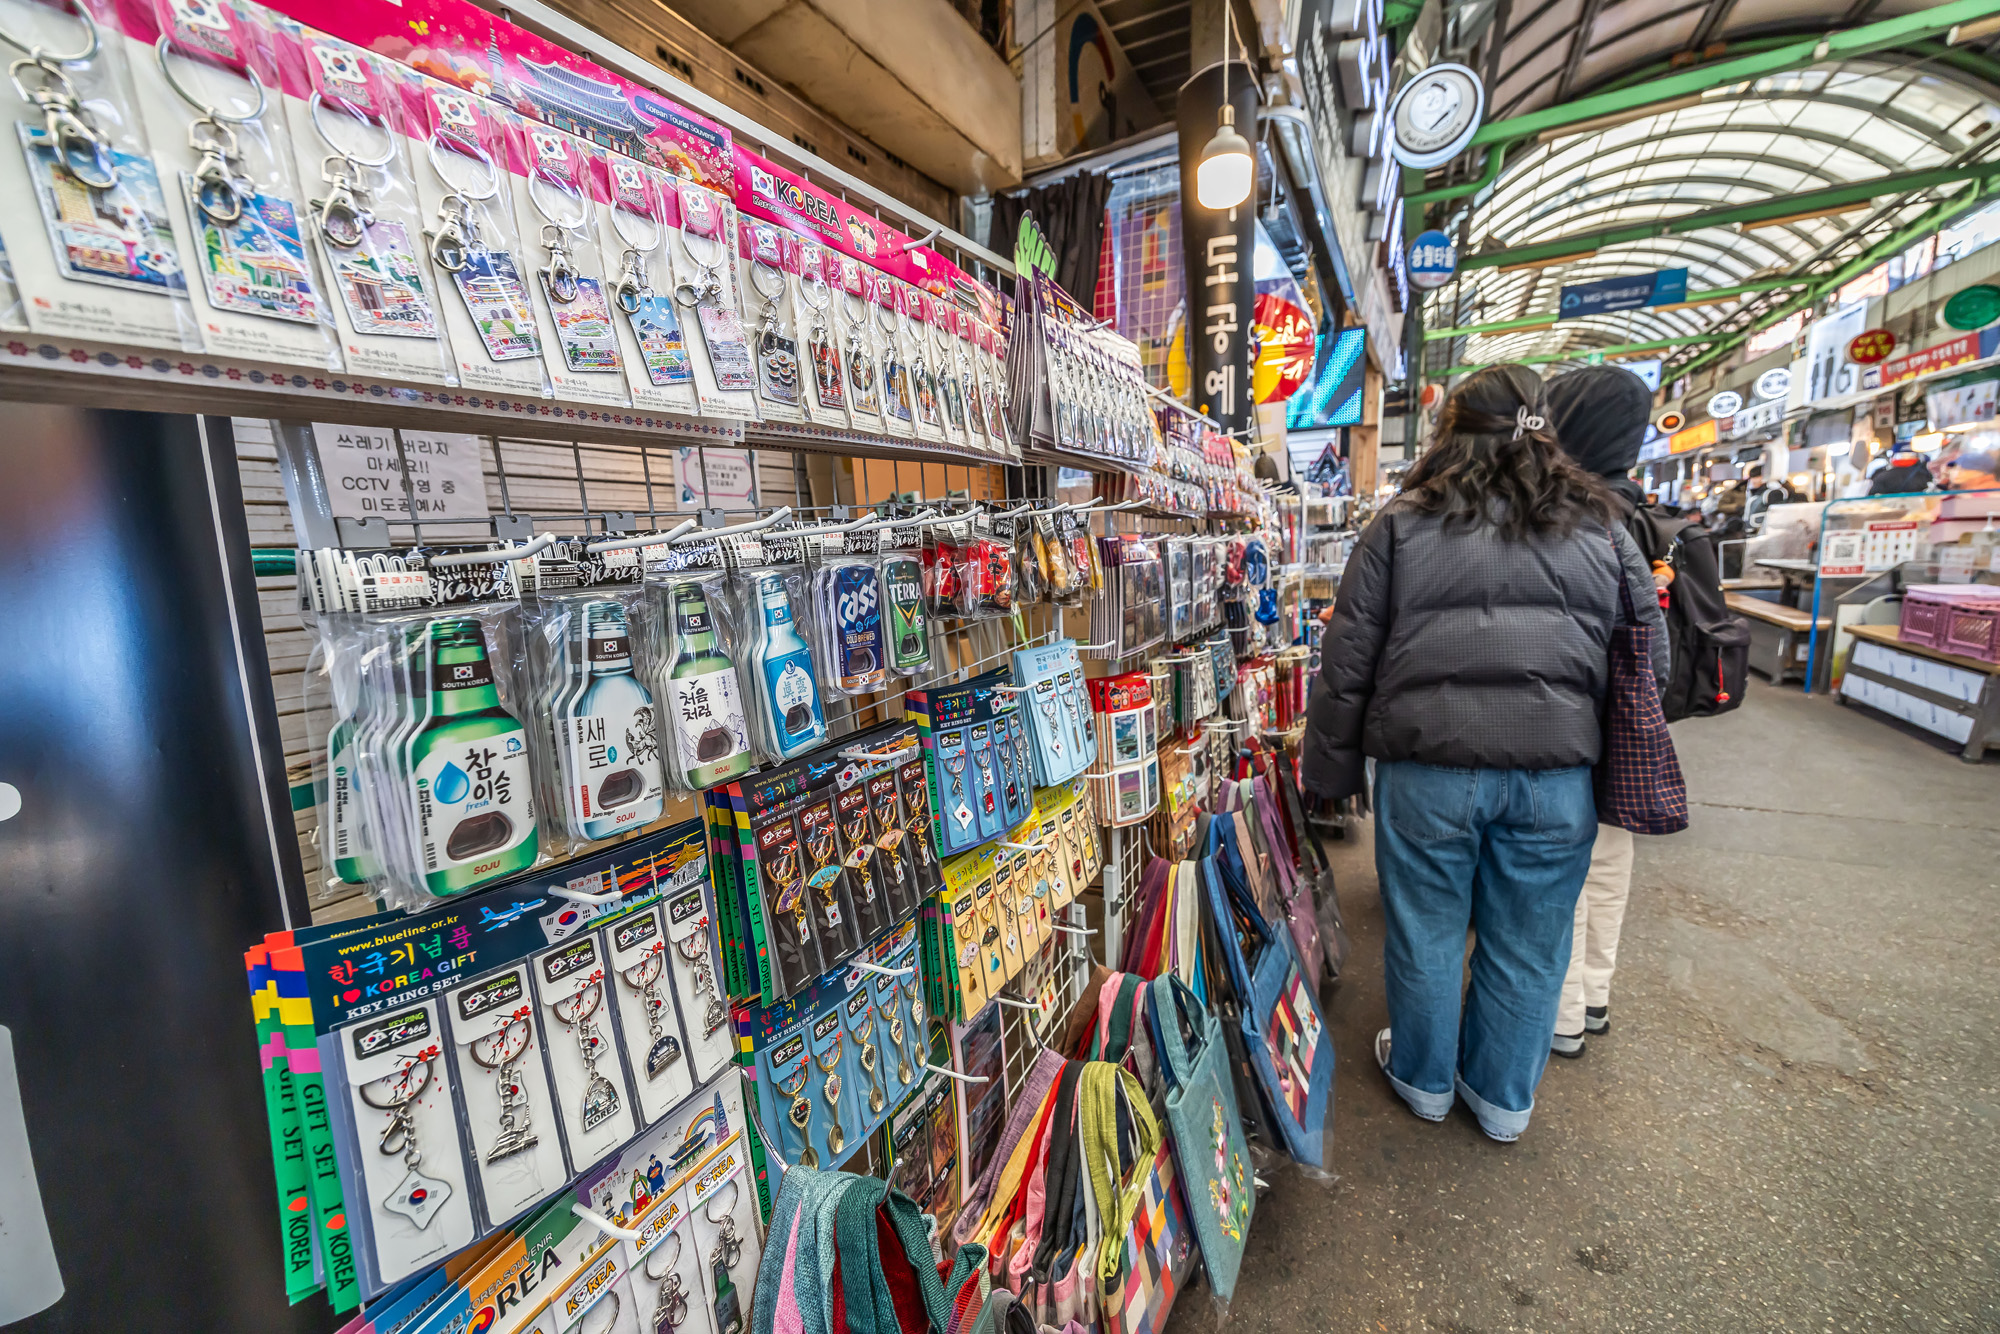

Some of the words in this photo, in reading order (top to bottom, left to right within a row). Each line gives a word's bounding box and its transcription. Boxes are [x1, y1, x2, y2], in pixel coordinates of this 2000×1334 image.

[439, 118, 479, 141] KOREA
[644, 103, 669, 119] Korean
[669, 112, 691, 130] Tourist
[690, 124, 717, 143] Souvenir
[537, 154, 570, 173] KOREA
[617, 184, 646, 202] KOREA
[752, 194, 783, 215] Korean
[782, 206, 822, 233] traditional
[776, 176, 844, 232] KOREA
[250, 288, 299, 305] KOREA
[383, 310, 422, 323] KOREA
[1205, 207, 1239, 438] 도공예
[337, 433, 390, 452] 쓰레기
[402, 440, 450, 456] 버리지
[367, 456, 430, 474] 마세요!!
[341, 476, 390, 491] CCTV
[441, 480, 456, 494] 중
[361, 497, 447, 513] 미도공예사
[848, 538, 880, 553] Korea
[896, 532, 921, 547] Korea
[675, 550, 721, 570] Korea
[766, 548, 802, 566] Korea
[379, 576, 424, 585] 판매가격
[447, 570, 492, 581] AWESOME
[589, 566, 643, 587] Korea
[436, 580, 511, 603] Korea
[888, 582, 922, 604] TERRA
[613, 651, 629, 659] KOREA
[442, 681, 466, 689] SOUTH
[467, 677, 490, 686] KOREA
[679, 686, 709, 707] 처음
[934, 695, 975, 713] 한국기념품
[682, 704, 713, 722] 처럼
[945, 711, 965, 720] KOREA
[964, 708, 976, 716] GIFT
[940, 721, 951, 729] KEY
[587, 717, 609, 770] 새로
[465, 747, 512, 805] 참이슬
[714, 764, 731, 775] SOJU
[754, 767, 801, 788] www.blueline.or.kr
[753, 773, 808, 807] 한국기념품
[926, 753, 934, 776] GIFT
[930, 779, 938, 798] SET
[934, 820, 943, 848] KOREA
[463, 797, 490, 815] fresh
[615, 811, 637, 824] SOJU
[473, 860, 501, 876] SOJU
[570, 876, 599, 890] 판매가격
[746, 866, 758, 897] GIFT
[751, 903, 762, 926] SET
[338, 914, 459, 956] www.blueline.or.kr
[757, 939, 765, 948] I
[327, 925, 473, 986] 한국기념품
[566, 947, 577, 957] KEY
[577, 942, 591, 952] RING
[567, 951, 594, 968] Korea
[332, 994, 340, 1007] I
[365, 967, 434, 998] KOREA
[437, 950, 478, 974] GIFT
[487, 982, 499, 992] KEY
[499, 974, 517, 987] RING
[760, 958, 771, 995] KOREA
[346, 999, 385, 1020] KEY
[386, 985, 430, 1007] RING
[432, 973, 463, 992] SET
[488, 983, 521, 1004] Korea
[405, 1011, 426, 1025] RING
[775, 1011, 804, 1031] KOREA
[804, 999, 821, 1015] GIFT
[766, 1031, 784, 1044] KEY
[783, 1021, 803, 1037] RING
[801, 1013, 815, 1027] SET
[302, 1083, 329, 1136] GIFT
[587, 1104, 620, 1128] KOREA
[283, 1125, 305, 1162] SET
[313, 1144, 338, 1180] SET
[694, 1154, 737, 1197] KOREA
[286, 1184, 307, 1198] I
[759, 1182, 771, 1219] KOREA
[323, 1201, 343, 1215] I
[613, 1210, 626, 1227] N
[635, 1202, 680, 1252] KOREA
[289, 1213, 312, 1274] KOREA
[328, 1230, 356, 1293] KOREA
[465, 1277, 504, 1318] KOREA
[502, 1232, 555, 1285] SOUVENIR
[456, 1247, 563, 1334] OREA
[565, 1259, 617, 1317] KOREA
